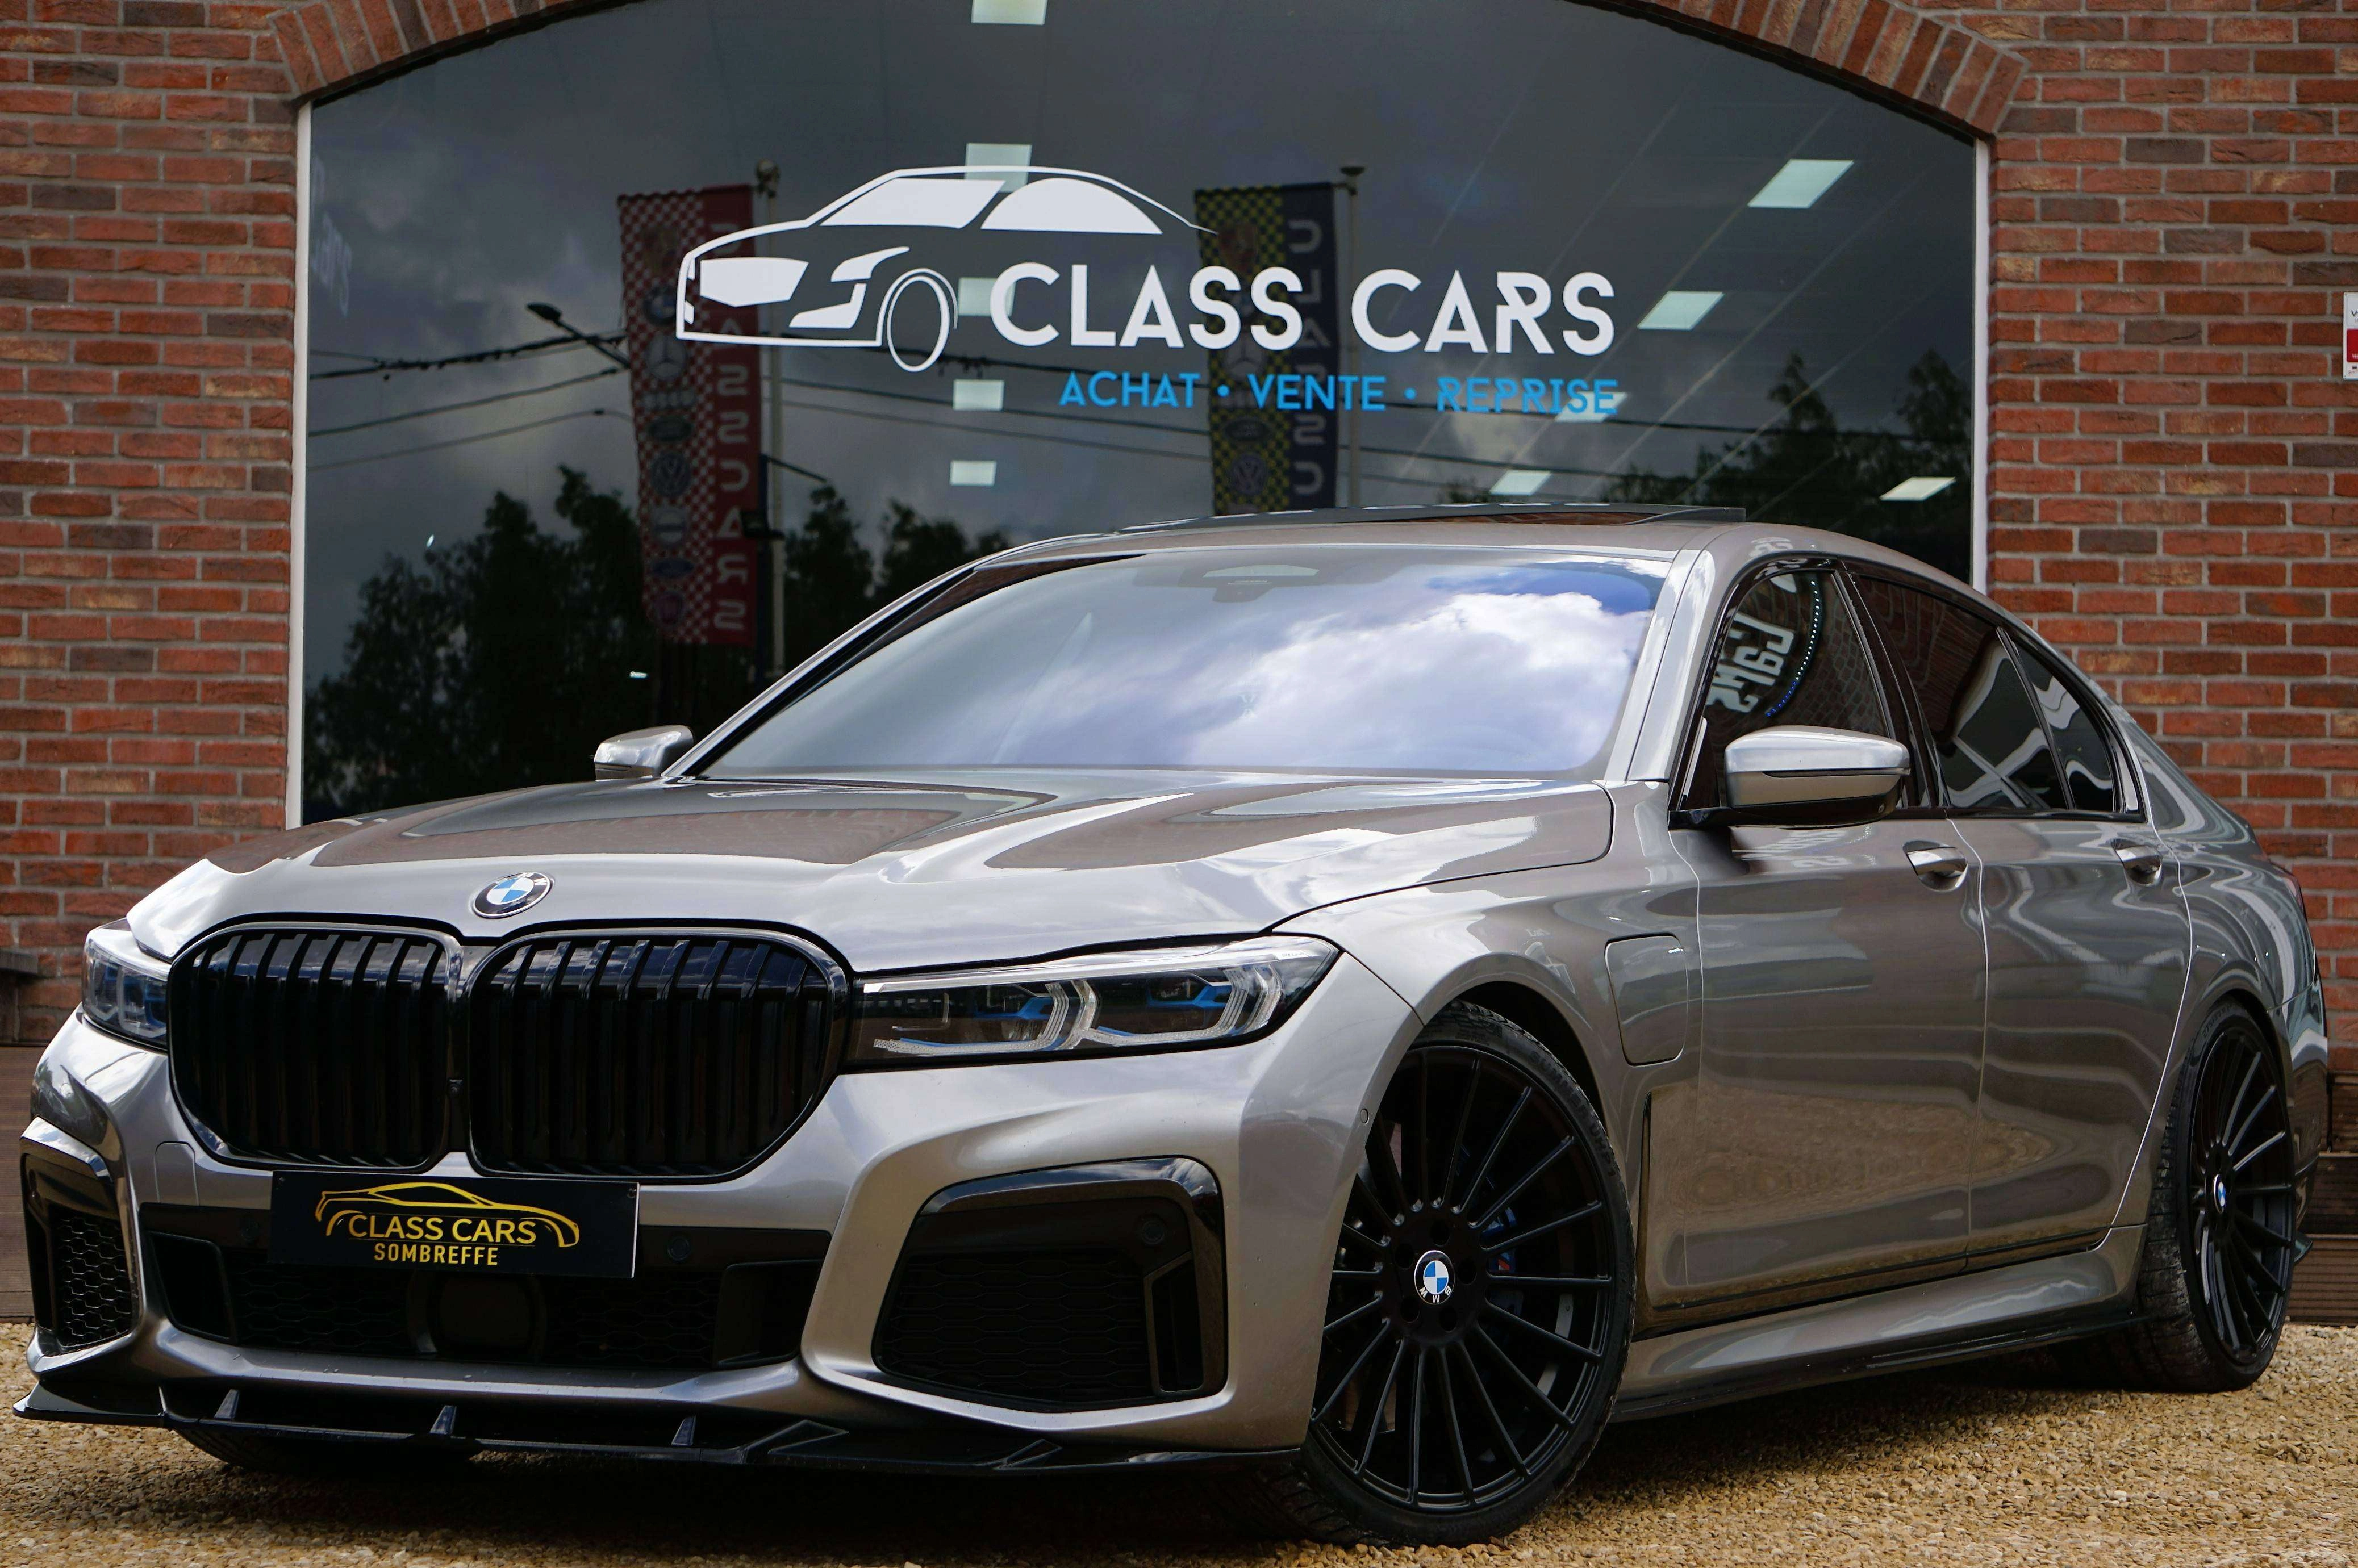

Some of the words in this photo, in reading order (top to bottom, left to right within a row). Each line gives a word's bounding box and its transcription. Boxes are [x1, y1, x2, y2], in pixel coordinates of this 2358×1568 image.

[990, 262, 1302, 350] CLASS
[1351, 269, 1614, 355] CARS
[1059, 371, 1201, 408] ACHAT
[1247, 374, 1387, 412] VENTE
[1436, 376, 1619, 415] REPRISE
[349, 1214, 444, 1241] CLASS
[452, 1218, 537, 1244] CARS
[374, 1242, 499, 1266] SOMBREFFE
[1419, 1286, 1452, 1303] BMW
